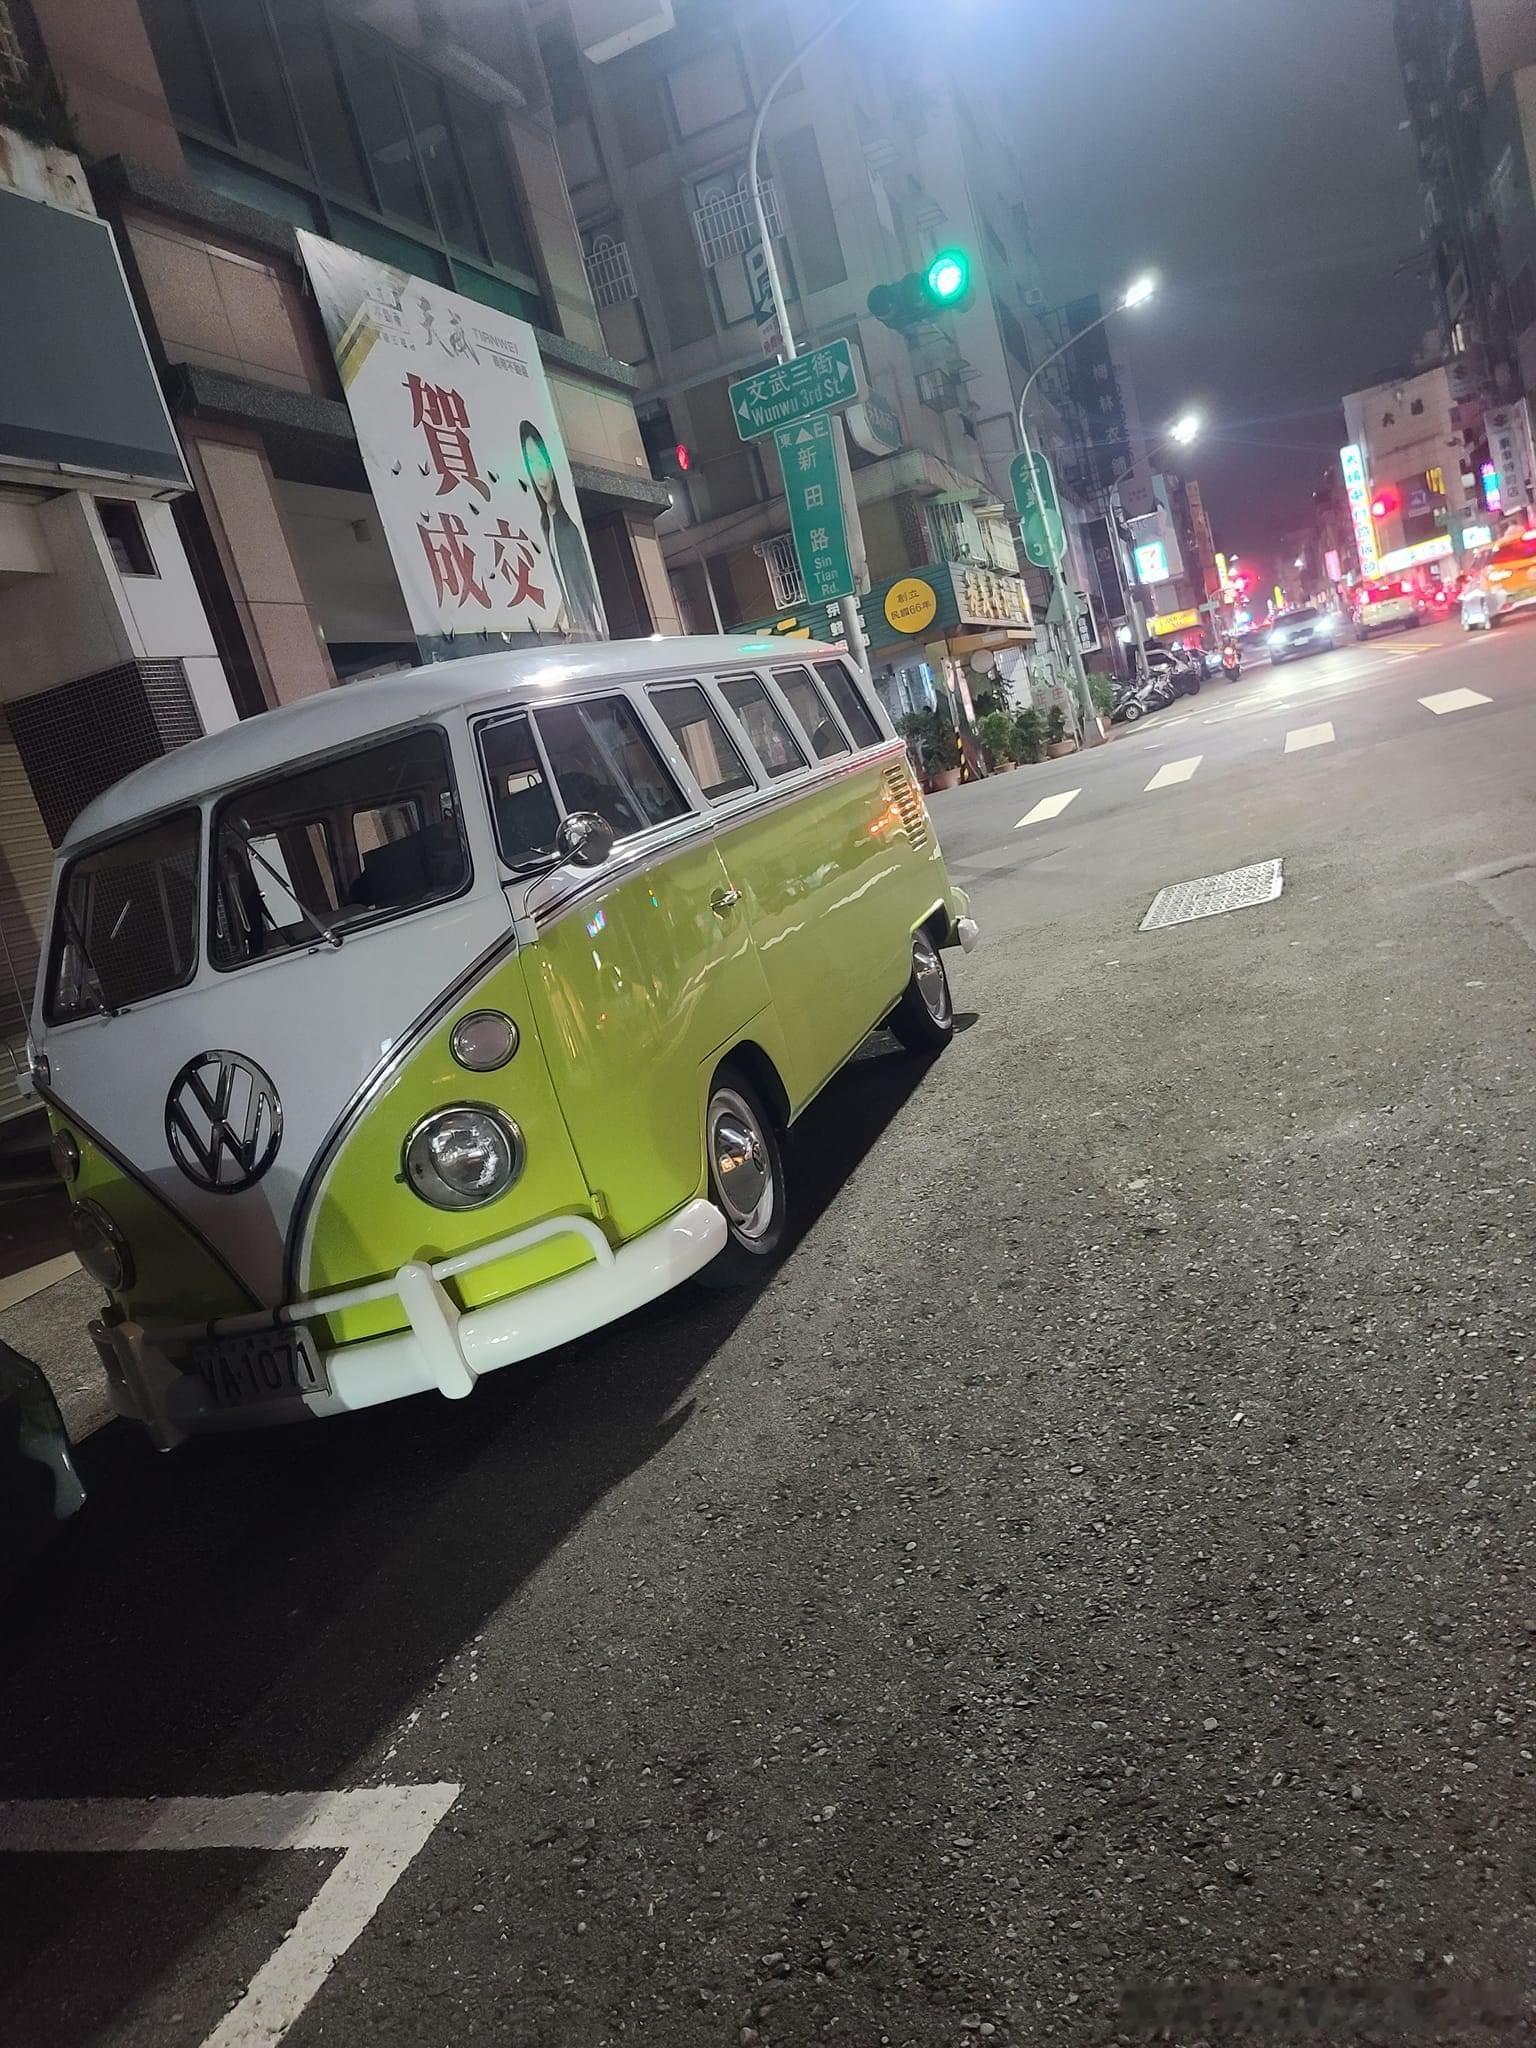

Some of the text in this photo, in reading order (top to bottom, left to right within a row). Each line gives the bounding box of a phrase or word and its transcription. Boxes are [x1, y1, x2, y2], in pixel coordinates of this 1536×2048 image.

[746, 351, 833, 406] 文武三街
[751, 377, 845, 427] Wunwu 3rd St.
[402, 372, 491, 502] 賀
[813, 421, 829, 438] E.
[778, 433, 793, 449] 東
[797, 445, 830, 553] 新田路
[415, 511, 547, 610] 成交
[814, 555, 833, 570] Sin
[813, 567, 838, 585] Tian
[821, 583, 840, 596] Rd.
[896, 589, 920, 603] 創立
[890, 600, 929, 621] 民國66年
[165, 1049, 284, 1194] VW
